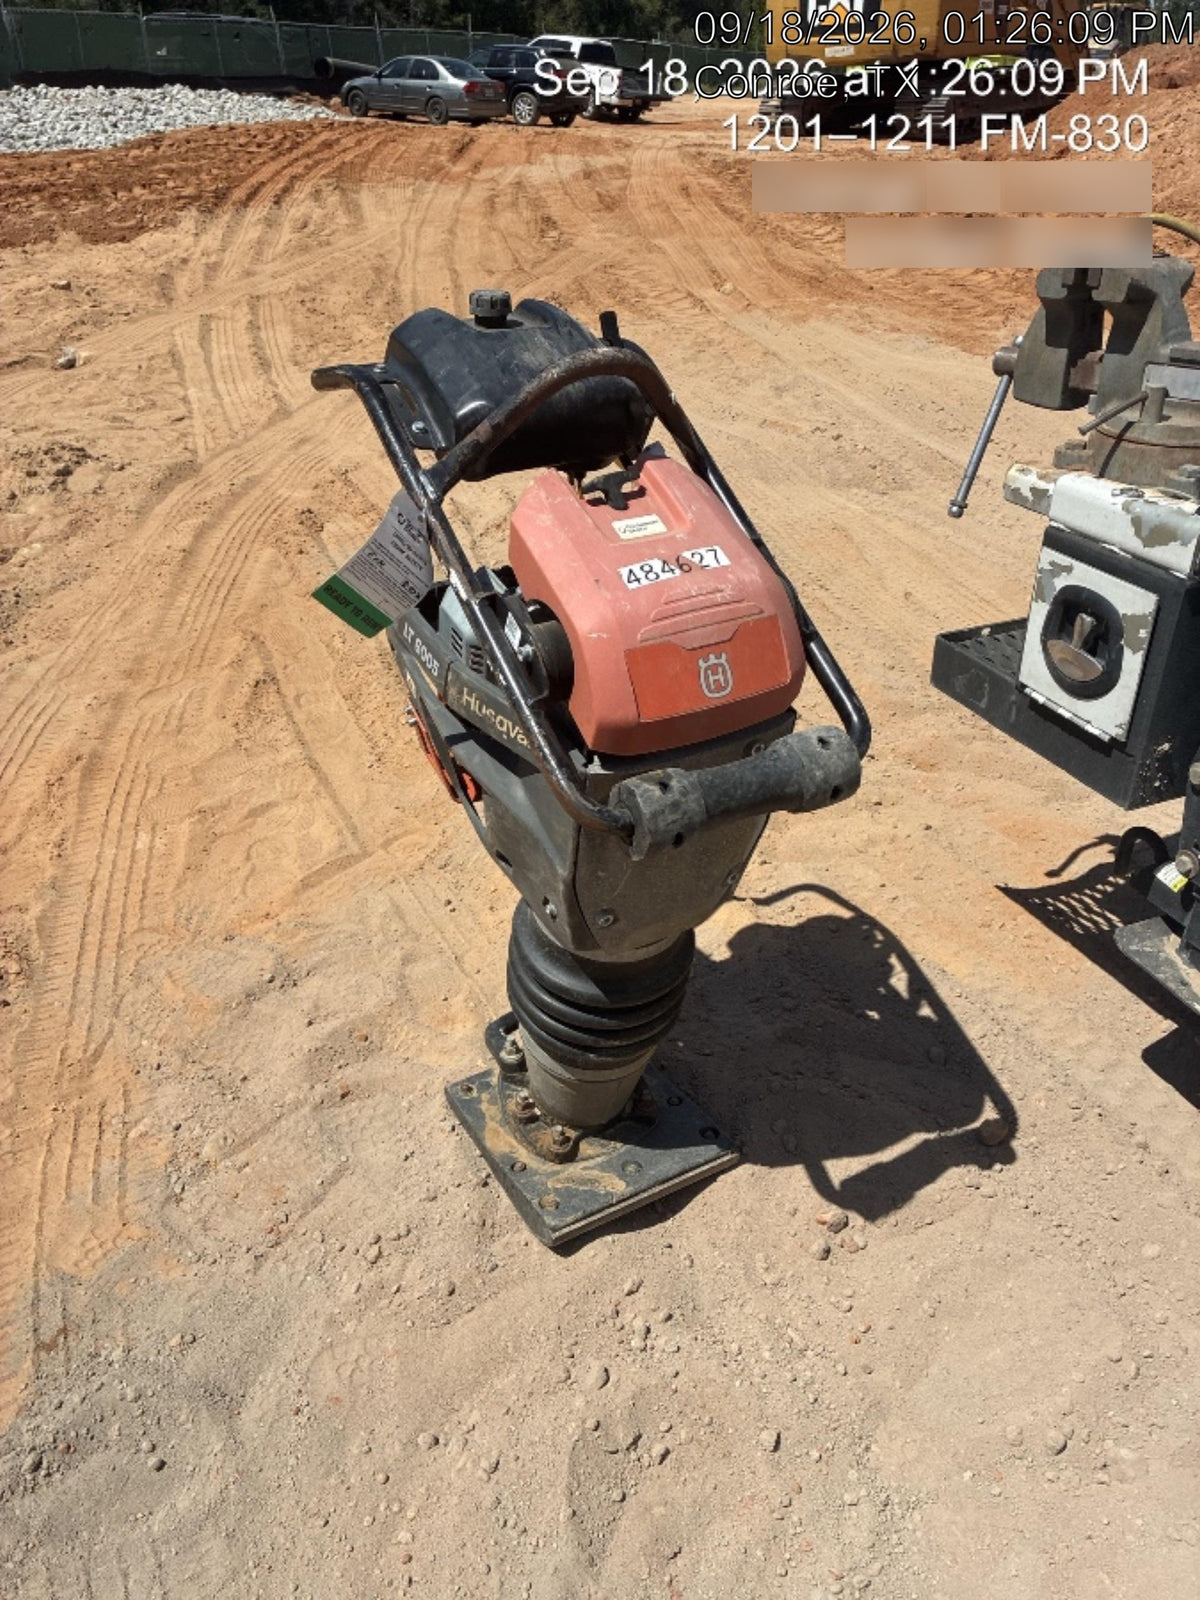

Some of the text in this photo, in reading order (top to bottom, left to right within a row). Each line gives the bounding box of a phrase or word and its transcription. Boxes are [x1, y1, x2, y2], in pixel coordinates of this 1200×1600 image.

[626, 549, 721, 585] 484627
[403, 622, 415, 644] LT
[463, 687, 531, 749] Husqva
